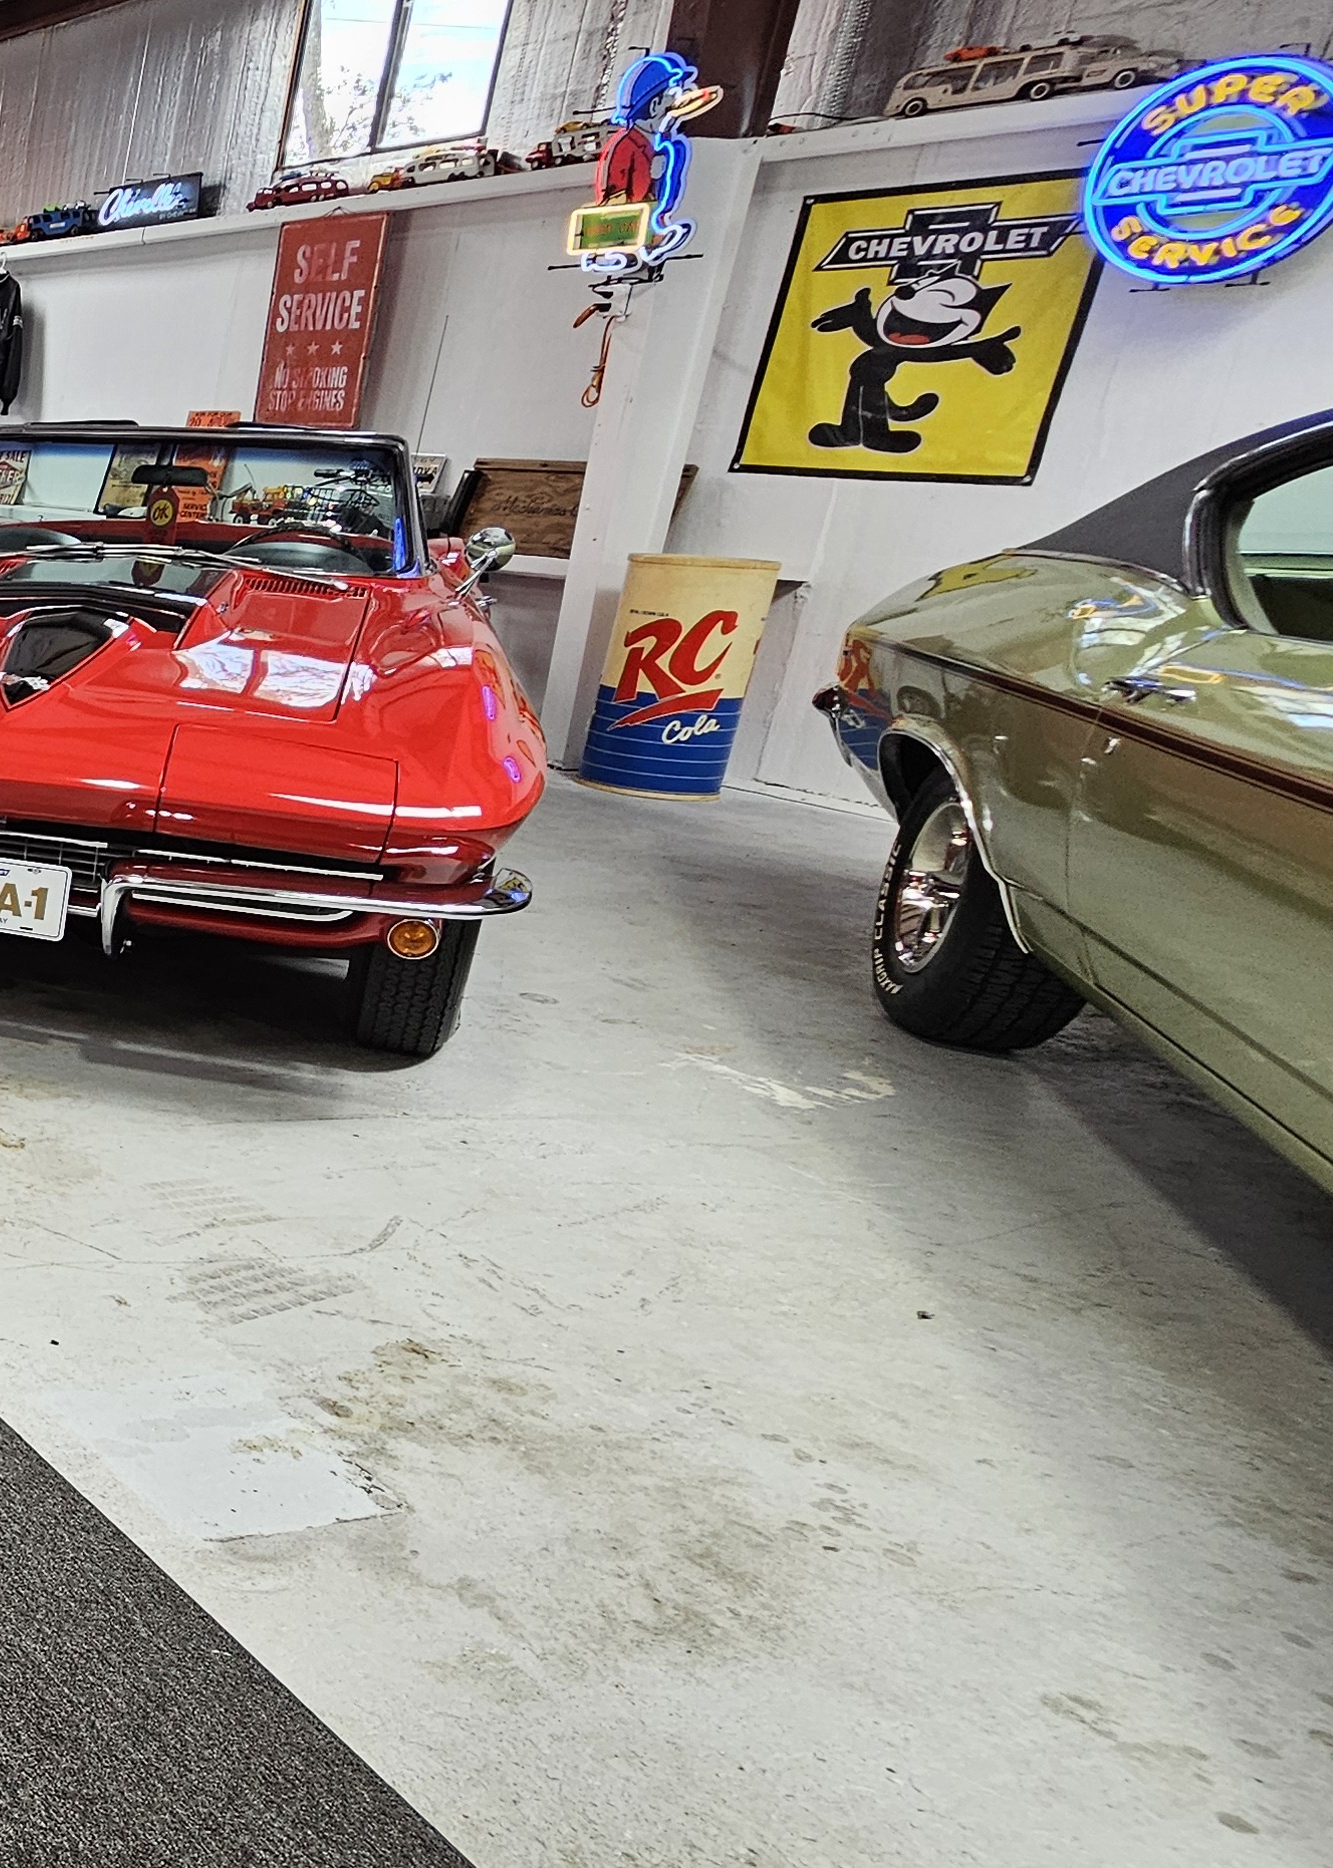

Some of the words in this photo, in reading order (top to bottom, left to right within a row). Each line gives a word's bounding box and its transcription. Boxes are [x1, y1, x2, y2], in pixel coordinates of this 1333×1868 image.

[1141, 72, 1323, 137] SUPER
[1108, 147, 1332, 197] CHEVROLET
[294, 240, 360, 284] SELF
[847, 226, 1050, 261] CHEVROLET
[276, 290, 366, 333] SERVICE
[274, 364, 290, 389] NO
[269, 389, 296, 412] STOP
[153, 503, 170, 521] OK
[183, 503, 208, 511] SERVIC
[613, 609, 739, 704] RC
[661, 714, 721, 745] Cola
[874, 843, 902, 940] CLASSIC
